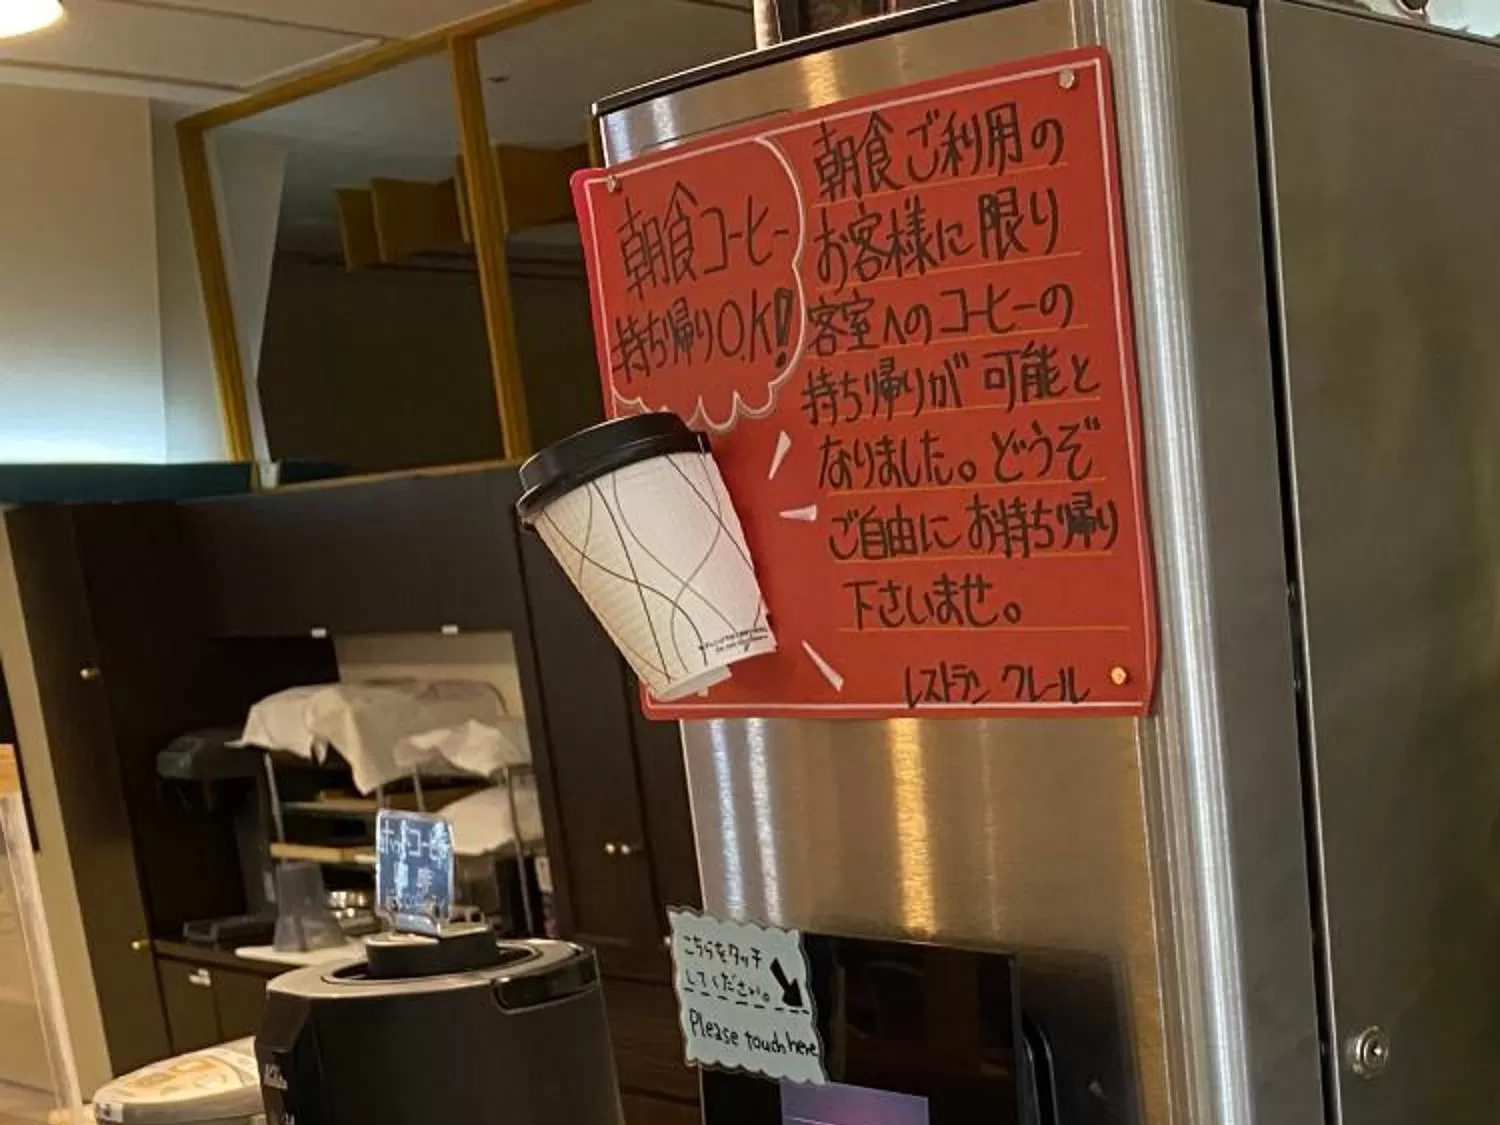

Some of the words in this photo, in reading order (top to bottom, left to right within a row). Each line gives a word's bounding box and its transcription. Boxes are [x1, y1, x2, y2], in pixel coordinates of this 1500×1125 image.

[813, 103, 1065, 202] 朝食ご利用の
[617, 180, 790, 301] 朝食コーヒー
[815, 186, 1059, 289] お客様に限り
[806, 283, 1073, 358] 客室へのコーヒーの
[801, 342, 1100, 425] 持ち帰りが可能と
[828, 492, 1119, 559] ご自由にお持ち帰り
[843, 571, 1020, 629] 下さいませ。
[689, 1008, 739, 1046] Please
[745, 1032, 786, 1055] touch
[785, 1031, 818, 1057] here
